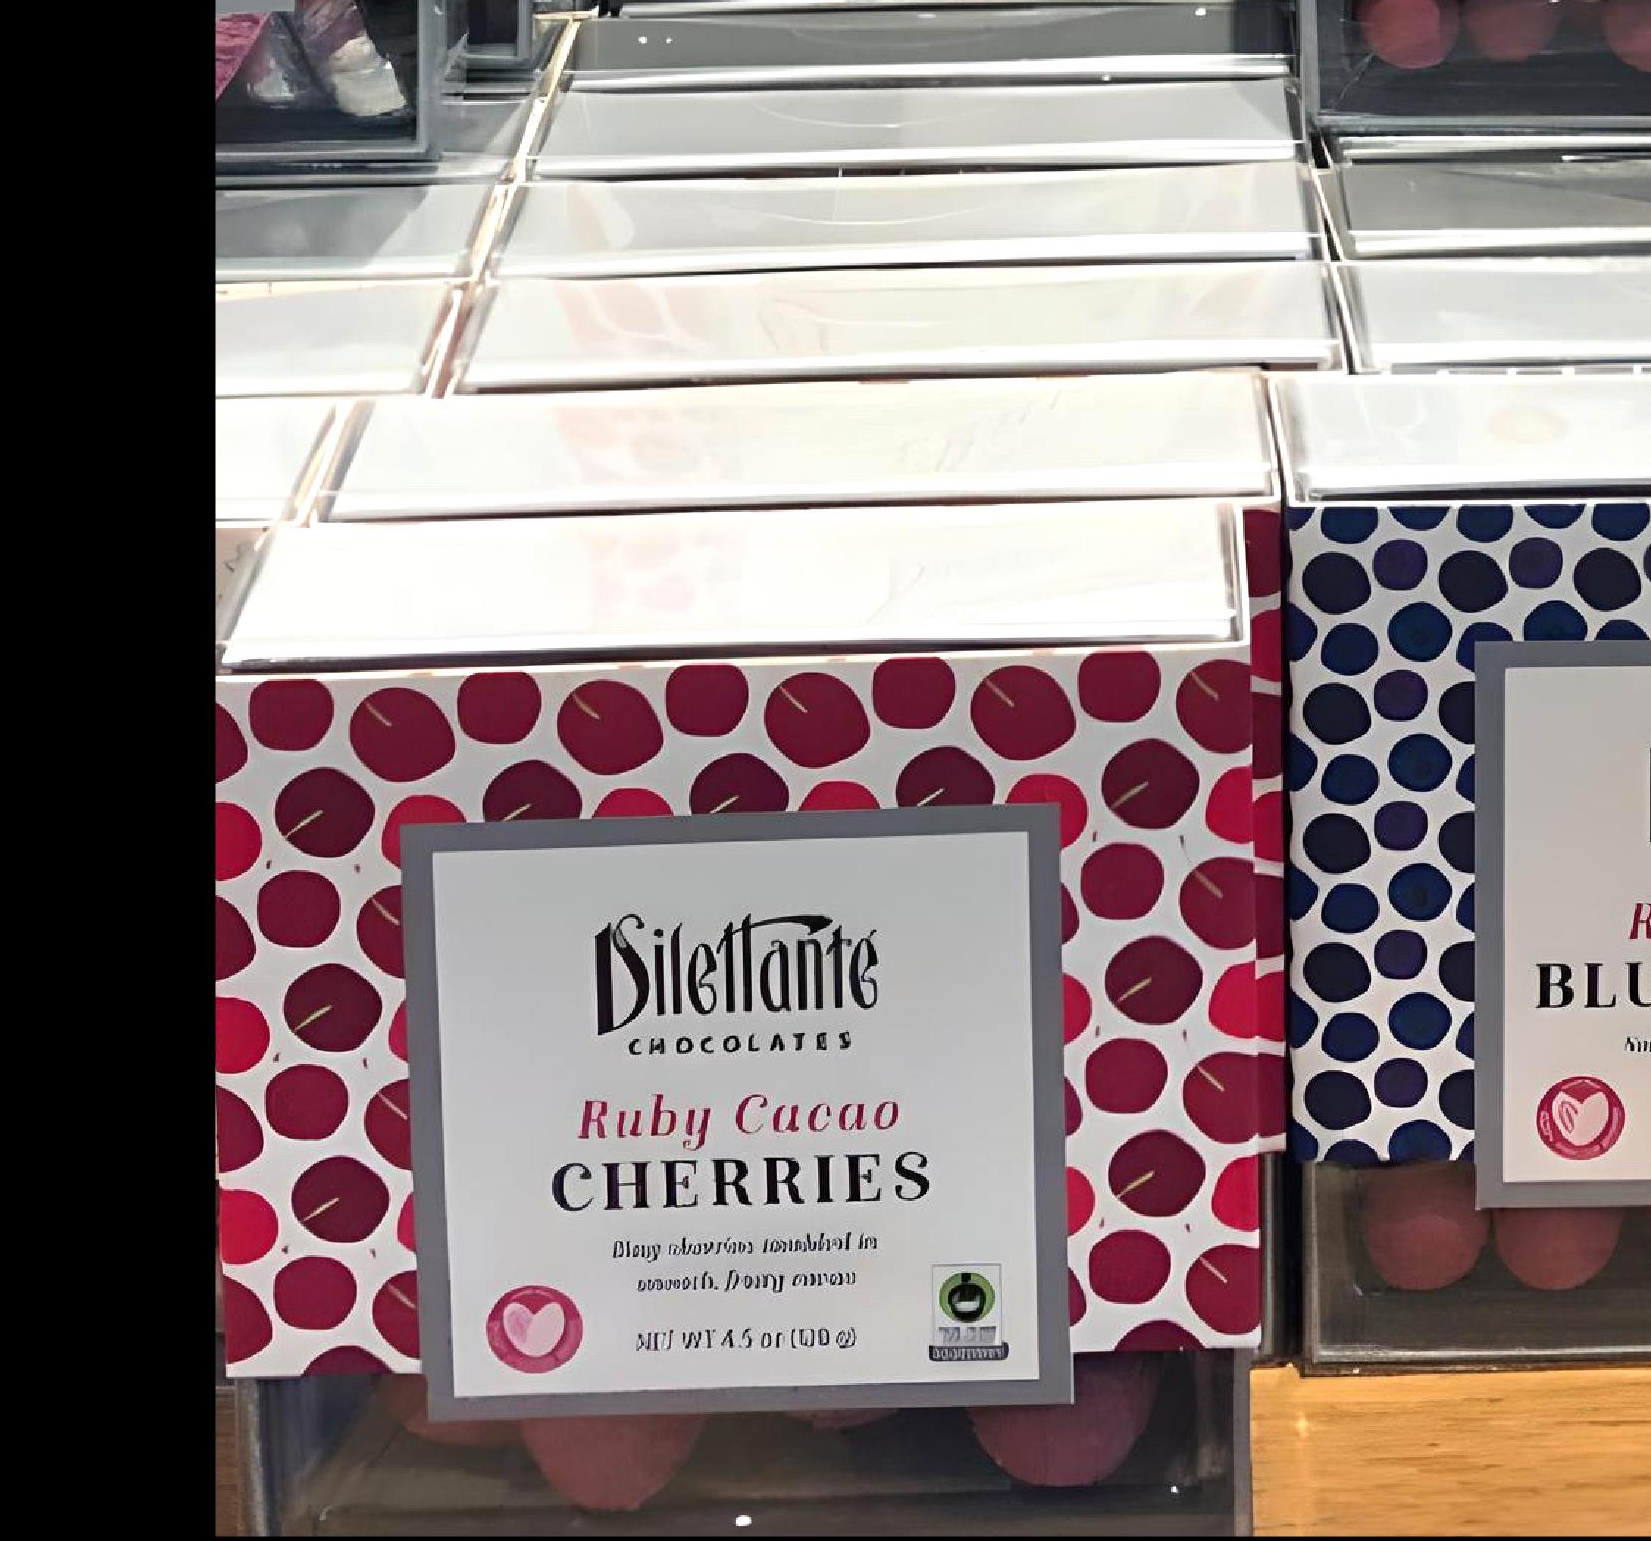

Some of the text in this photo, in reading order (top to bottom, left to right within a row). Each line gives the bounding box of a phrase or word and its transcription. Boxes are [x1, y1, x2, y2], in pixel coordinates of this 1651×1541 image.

[628, 1031, 853, 1056] CHOCOLATES
[576, 1092, 900, 1151] Ruby Cacao
[551, 1150, 931, 1213] CHERRIES
